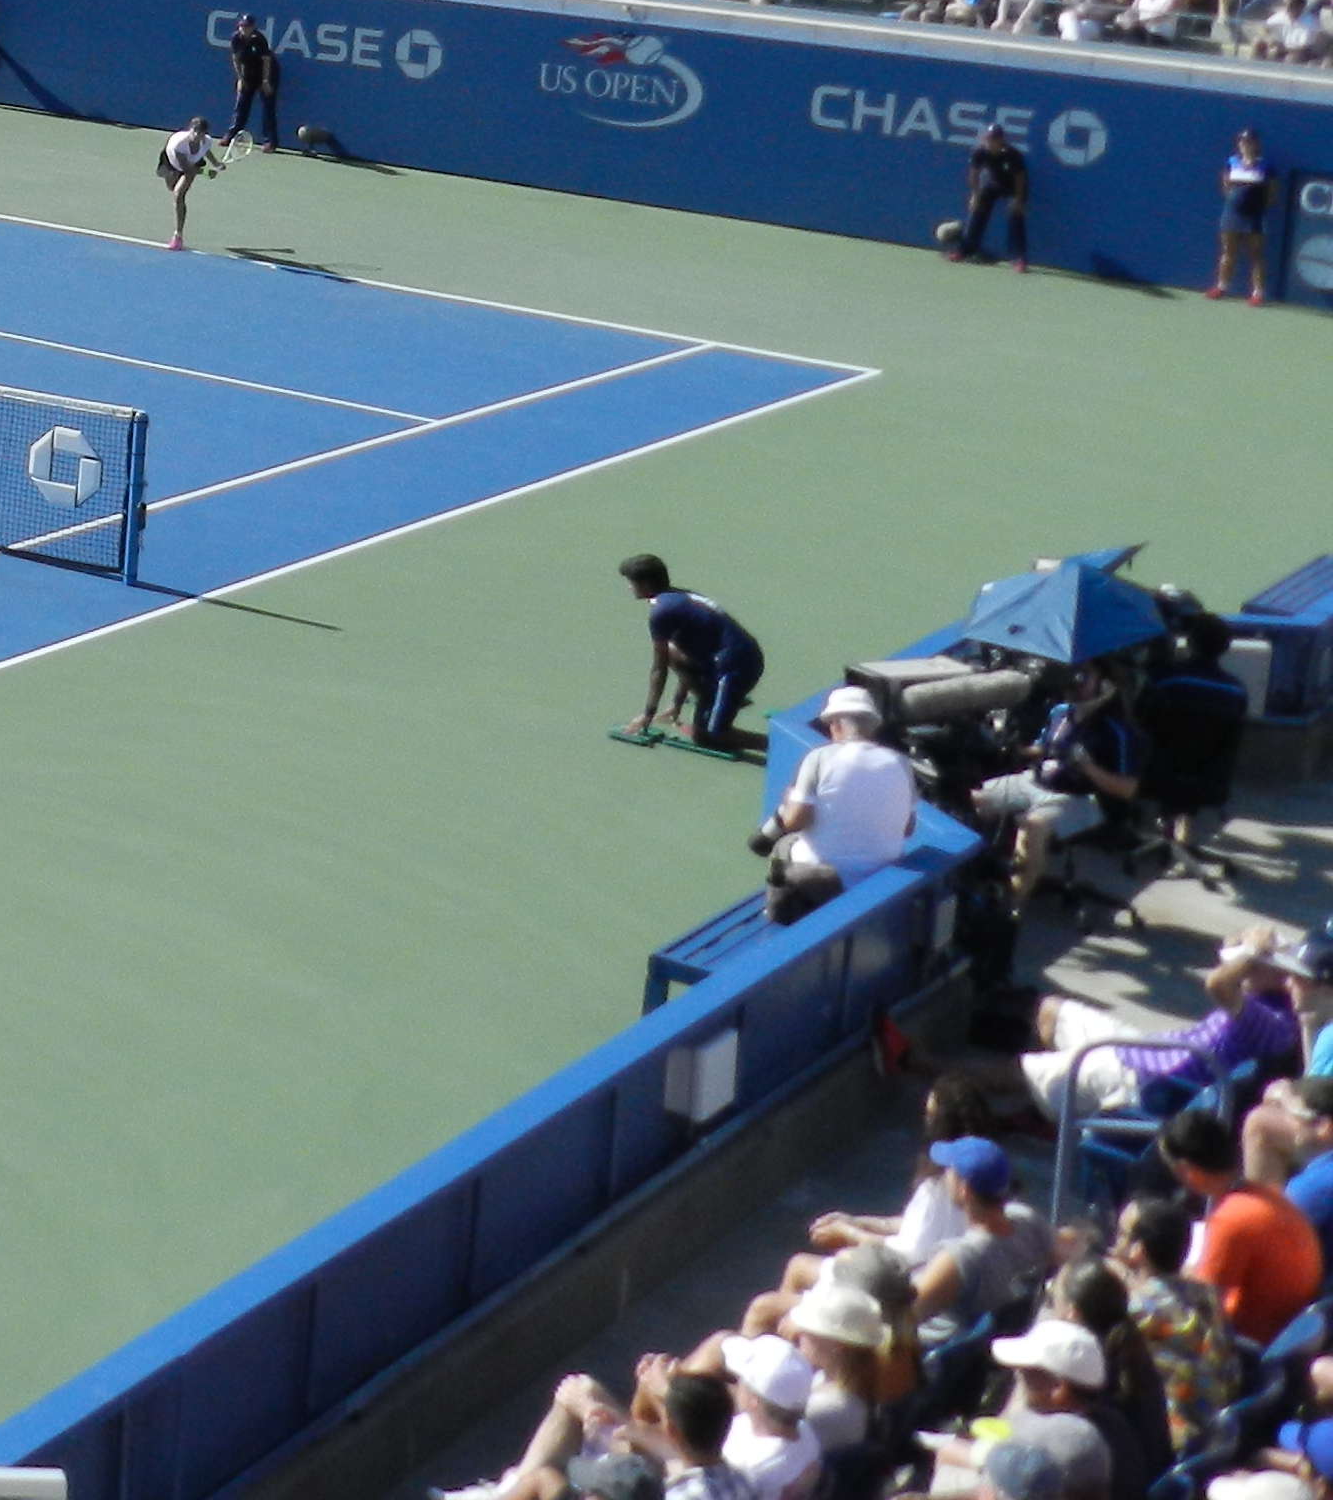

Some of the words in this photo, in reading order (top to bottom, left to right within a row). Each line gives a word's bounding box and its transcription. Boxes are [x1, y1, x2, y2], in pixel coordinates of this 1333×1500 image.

[540, 63, 577, 94] US
[585, 69, 678, 106] OPEN
[810, 85, 1033, 152] CHASE
